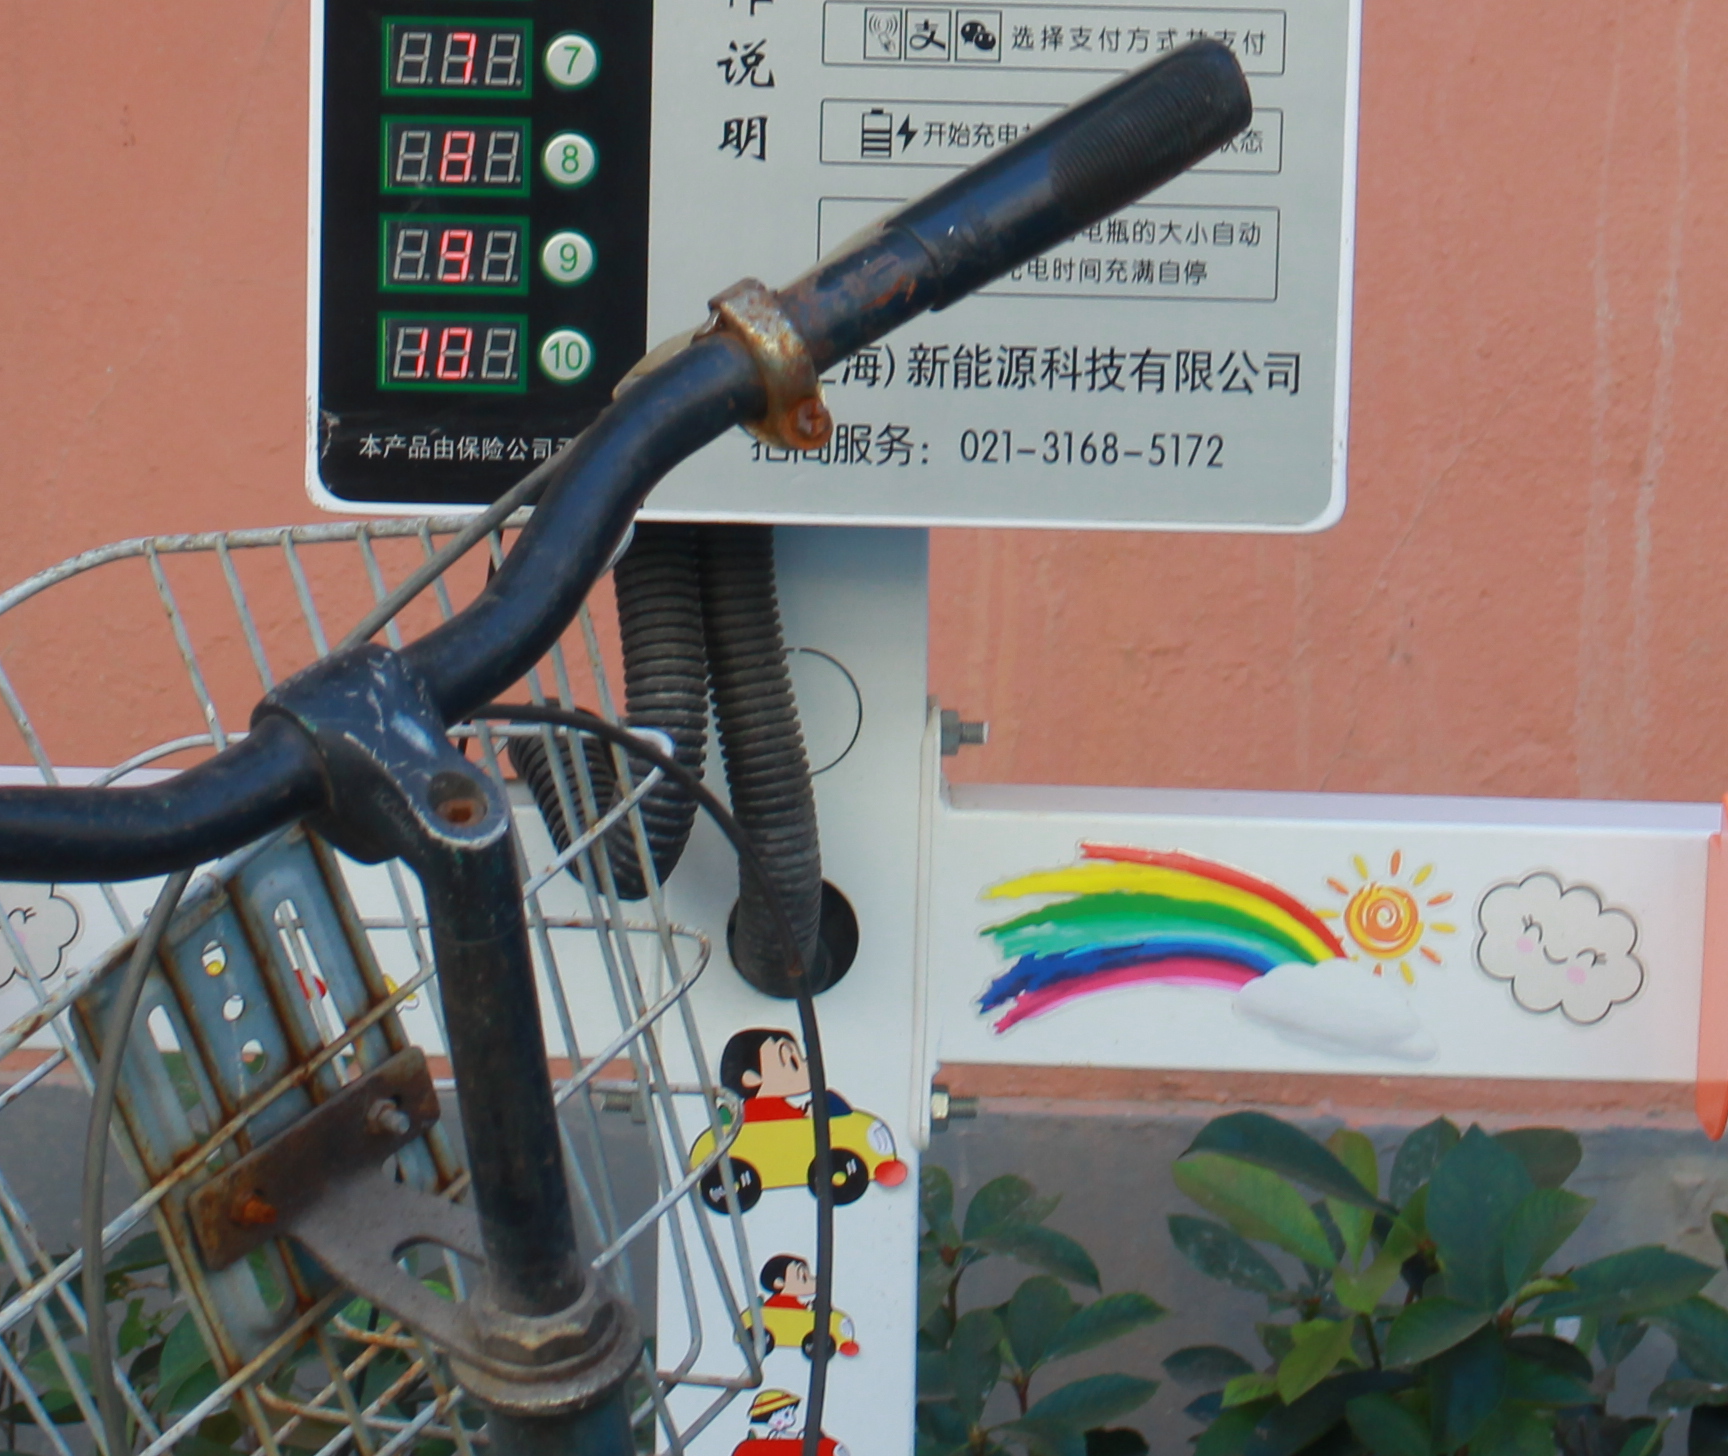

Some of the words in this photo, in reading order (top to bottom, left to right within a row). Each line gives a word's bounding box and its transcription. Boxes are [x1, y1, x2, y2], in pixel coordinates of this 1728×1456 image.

[1011, 24, 1267, 56] 选择支付方式支付
[563, 46, 582, 76] 7
[922, 121, 1031, 149] 开始充电
[561, 143, 580, 174] 8
[558, 242, 578, 273] 9
[548, 339, 584, 371] 10
[822, 341, 1302, 396] 海)新能源科技有限公司
[959, 429, 1225, 469] 021-3168-5172
